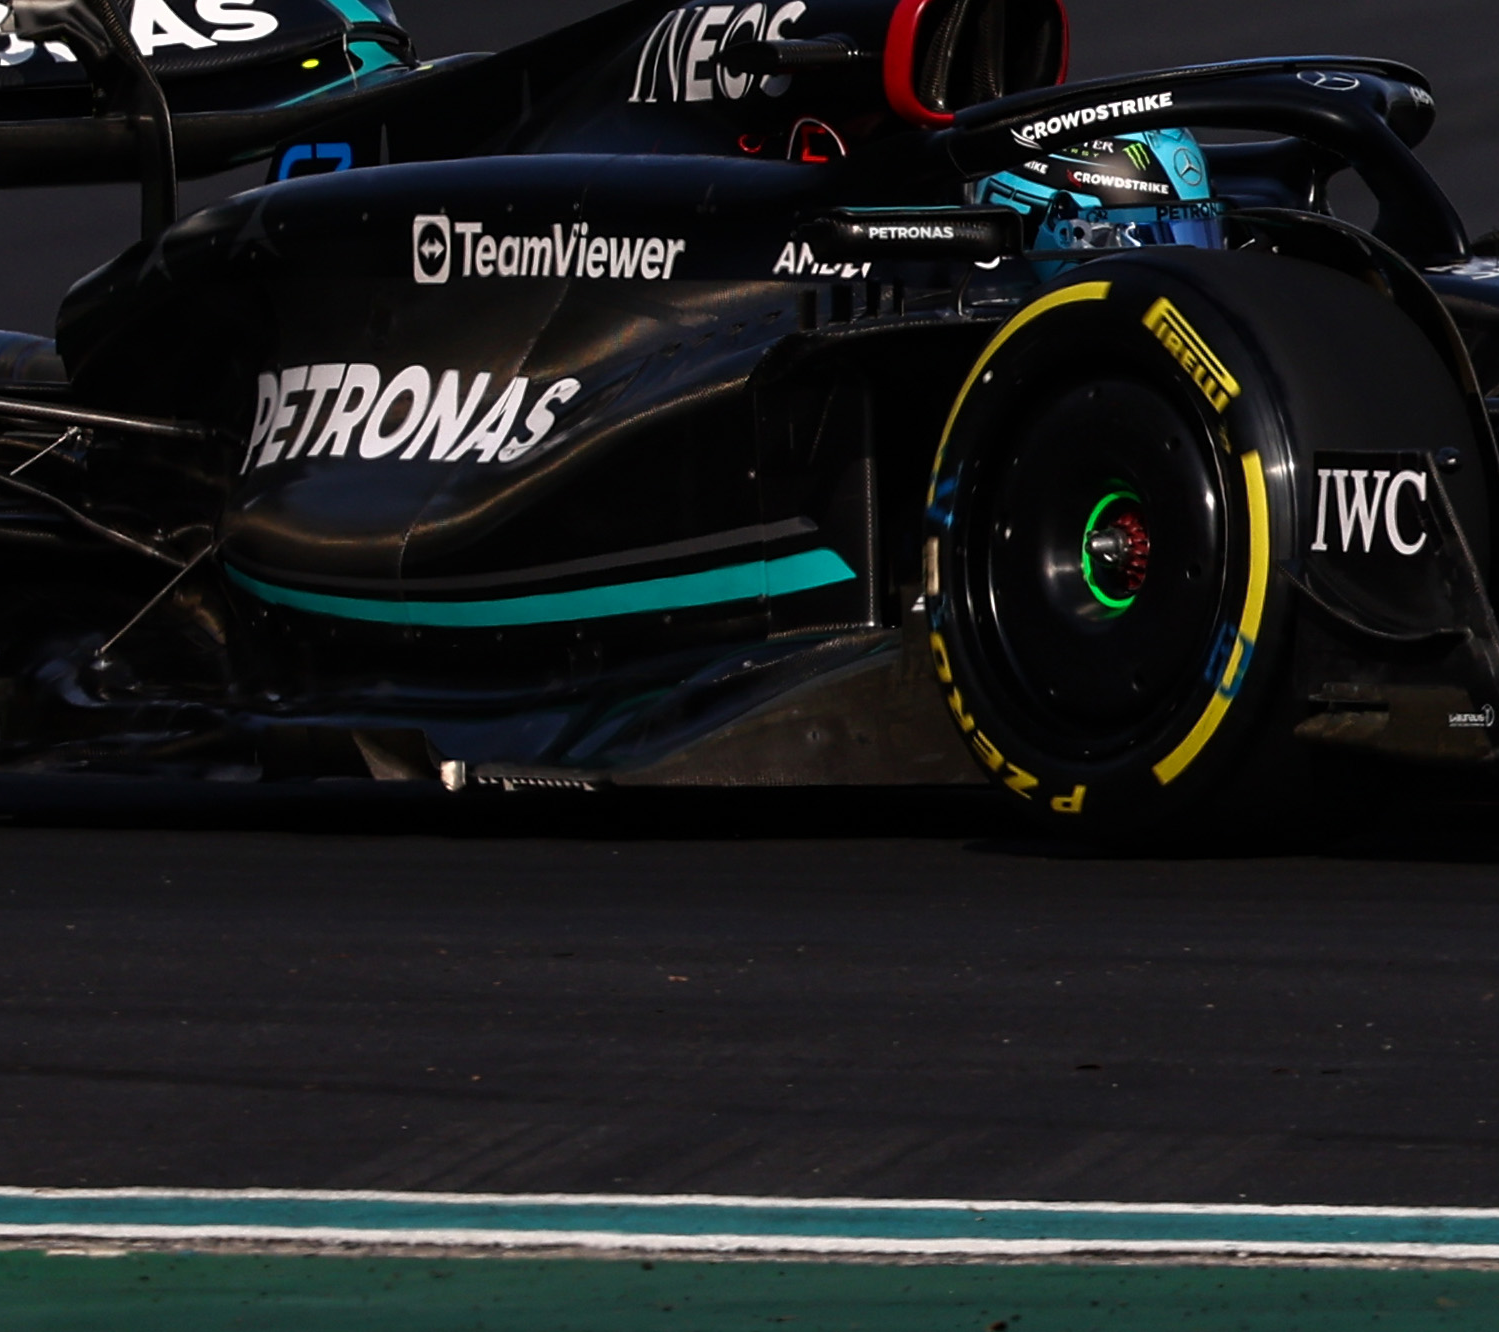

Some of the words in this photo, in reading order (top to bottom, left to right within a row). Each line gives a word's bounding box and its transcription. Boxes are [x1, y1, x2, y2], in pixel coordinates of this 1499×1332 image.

[1019, 90, 1174, 141] CROWDSTRIKE
[1072, 170, 1170, 195] CROWDSTRIKE
[454, 220, 687, 281] TeamViewer
[867, 225, 955, 241] PETRONAS
[1142, 296, 1243, 414] PIRELLI
[240, 361, 582, 476] PETRONAS
[1310, 468, 1428, 557] IWC
[930, 632, 1041, 801] ZERO
[1050, 783, 1087, 815] P
